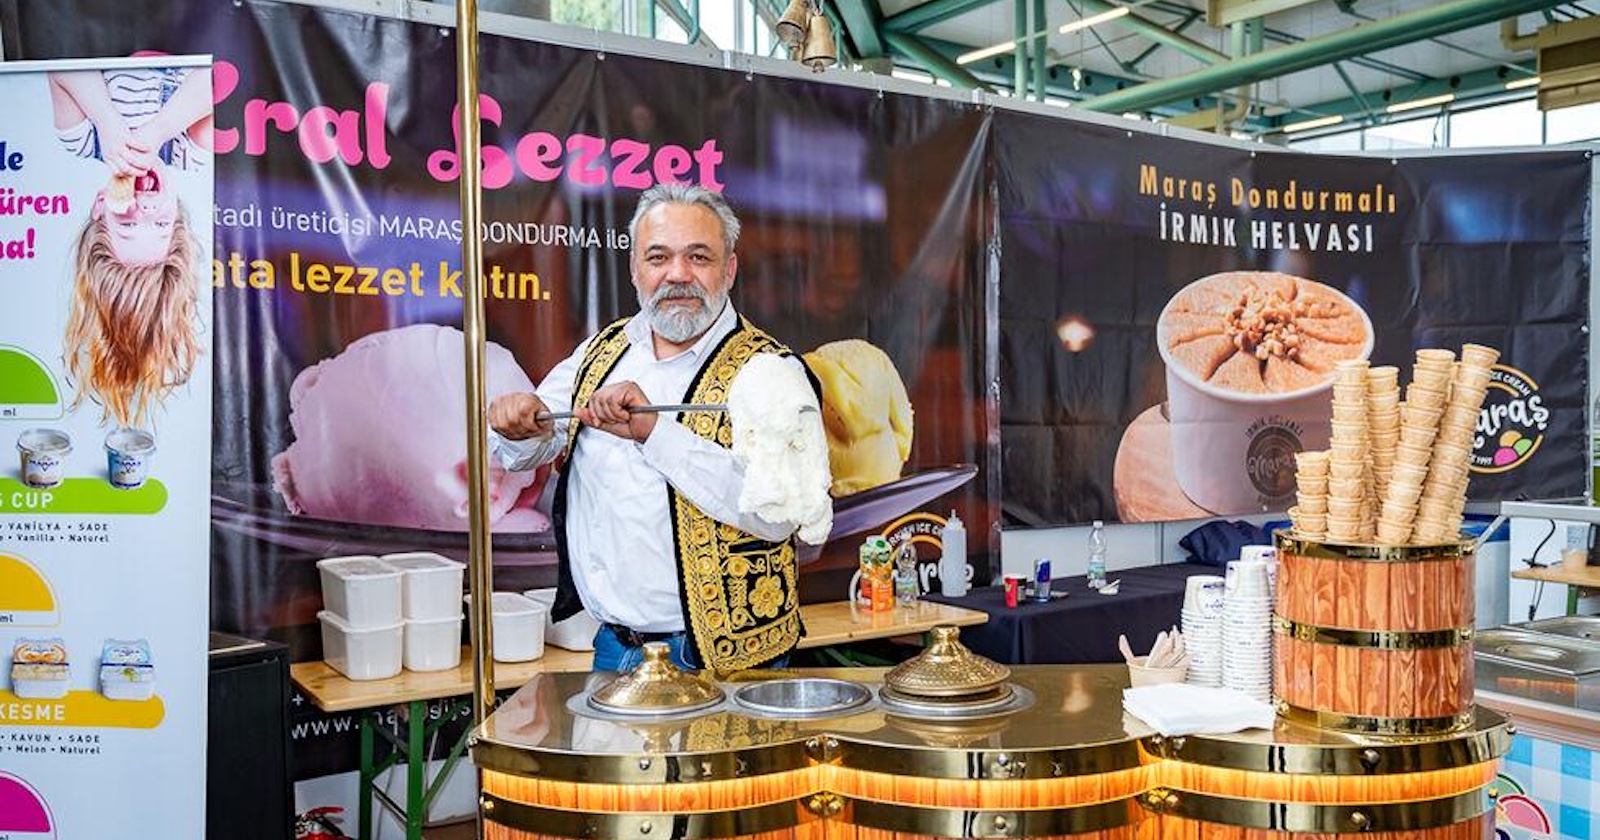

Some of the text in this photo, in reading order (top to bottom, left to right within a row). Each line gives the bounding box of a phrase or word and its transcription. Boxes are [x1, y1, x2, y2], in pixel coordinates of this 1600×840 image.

[427, 93, 725, 194] Lezzet
[1139, 163, 1396, 213] Maraş Dondurmalı
[271, 206, 371, 237] üreticisi
[379, 214, 463, 243] MARAŞ
[606, 230, 630, 250] ile
[1251, 220, 1373, 252] HELVASI
[290, 252, 424, 297] lezzet
[440, 261, 550, 300] ktın.
[1503, 374, 1531, 396] CREAM
[1473, 395, 1549, 449] araş
[12, 493, 53, 508] CUP
[8, 521, 108, 531] VANİLYA SADE
[17, 534, 109, 542] Vanilla Naturel
[11, 734, 100, 743] KAVUN SADE
[16, 745, 100, 754] Melon Naturel
